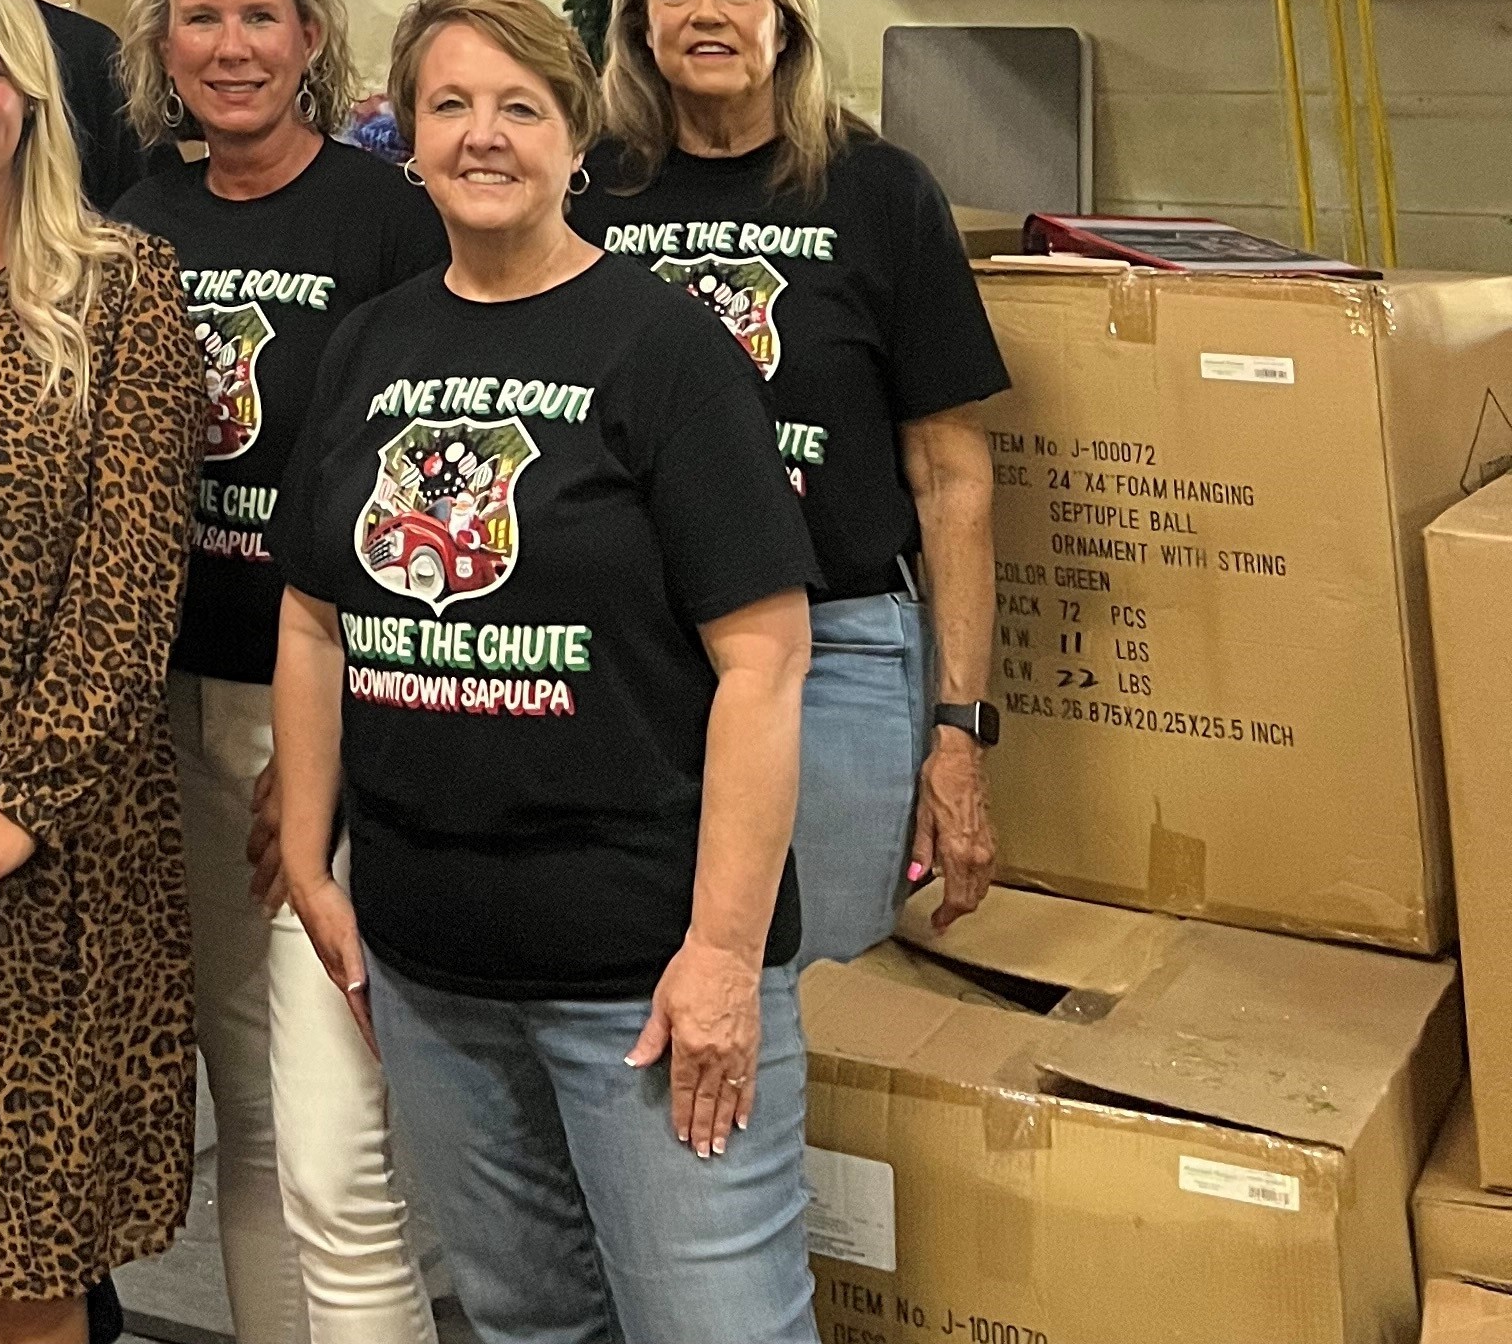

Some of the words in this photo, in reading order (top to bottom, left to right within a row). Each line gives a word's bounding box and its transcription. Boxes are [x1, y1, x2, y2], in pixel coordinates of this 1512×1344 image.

[604, 222, 685, 254] DRIVE
[686, 221, 739, 253] THE
[738, 223, 838, 261] ROUTE
[194, 269, 244, 301] THE
[239, 269, 336, 310] ROUTE
[366, 378, 443, 421] RIVE
[440, 376, 500, 415] THE
[988, 431, 1024, 454] TEM
[1071, 438, 1157, 465] J-100072
[223, 484, 279, 522] CHU
[993, 464, 1033, 489] ESC.
[1173, 478, 1254, 507] HANGING
[1049, 501, 1139, 530] SEPTUPLE
[1150, 510, 1197, 534] BALL
[202, 525, 272, 560] SAPUL
[1051, 533, 1148, 564] ORNAMENT
[1160, 544, 1208, 568] WITH
[1217, 550, 1287, 576] STRING
[994, 561, 1047, 585] COLOR
[1054, 565, 1111, 592] GREEN
[995, 592, 1041, 616] PACK
[1057, 599, 1081, 623] 72
[1110, 605, 1148, 629] PCS
[341, 612, 418, 664] RUISE
[418, 619, 477, 669] THE
[476, 624, 592, 672] CHUTE
[1060, 631, 1082, 654] 11
[1115, 638, 1150, 662] LBS
[348, 665, 461, 712] DOWNTOWN
[461, 676, 577, 717] SAPULPA
[1056, 668, 1099, 688] 22
[1118, 672, 1152, 696] LBS
[1250, 720, 1294, 747] INCH
[830, 1279, 884, 1316] ITEM
